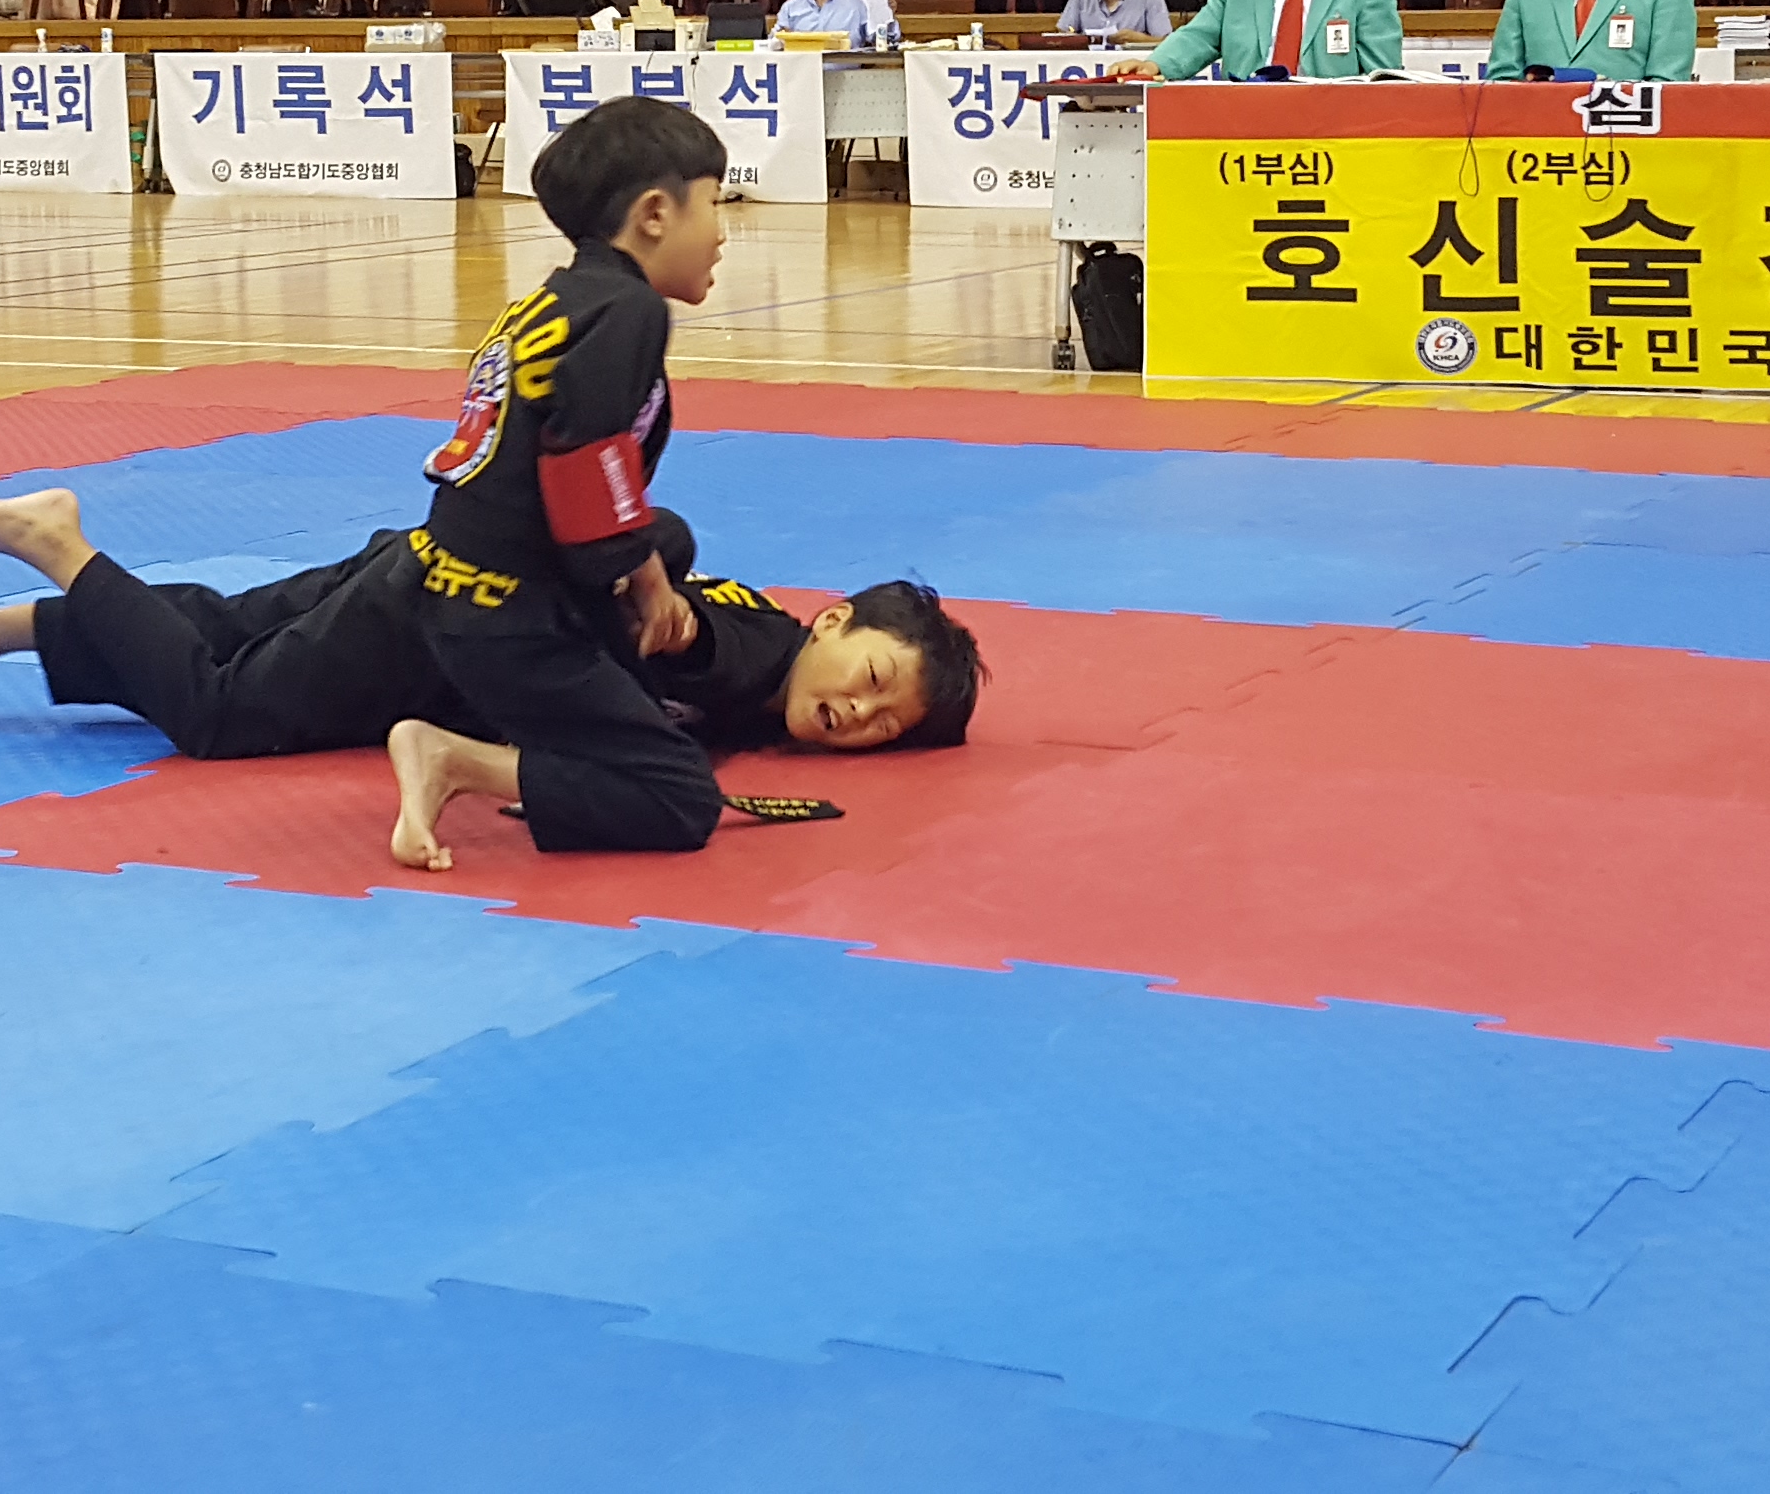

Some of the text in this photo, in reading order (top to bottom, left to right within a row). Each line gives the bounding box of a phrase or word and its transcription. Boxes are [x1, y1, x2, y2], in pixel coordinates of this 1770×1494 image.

[192, 62, 417, 137] 기록석
[239, 162, 400, 180] 충청남도합기도중앙협회
[1218, 150, 1335, 187] (1부심)
[1505, 149, 1632, 188] (2부심)
